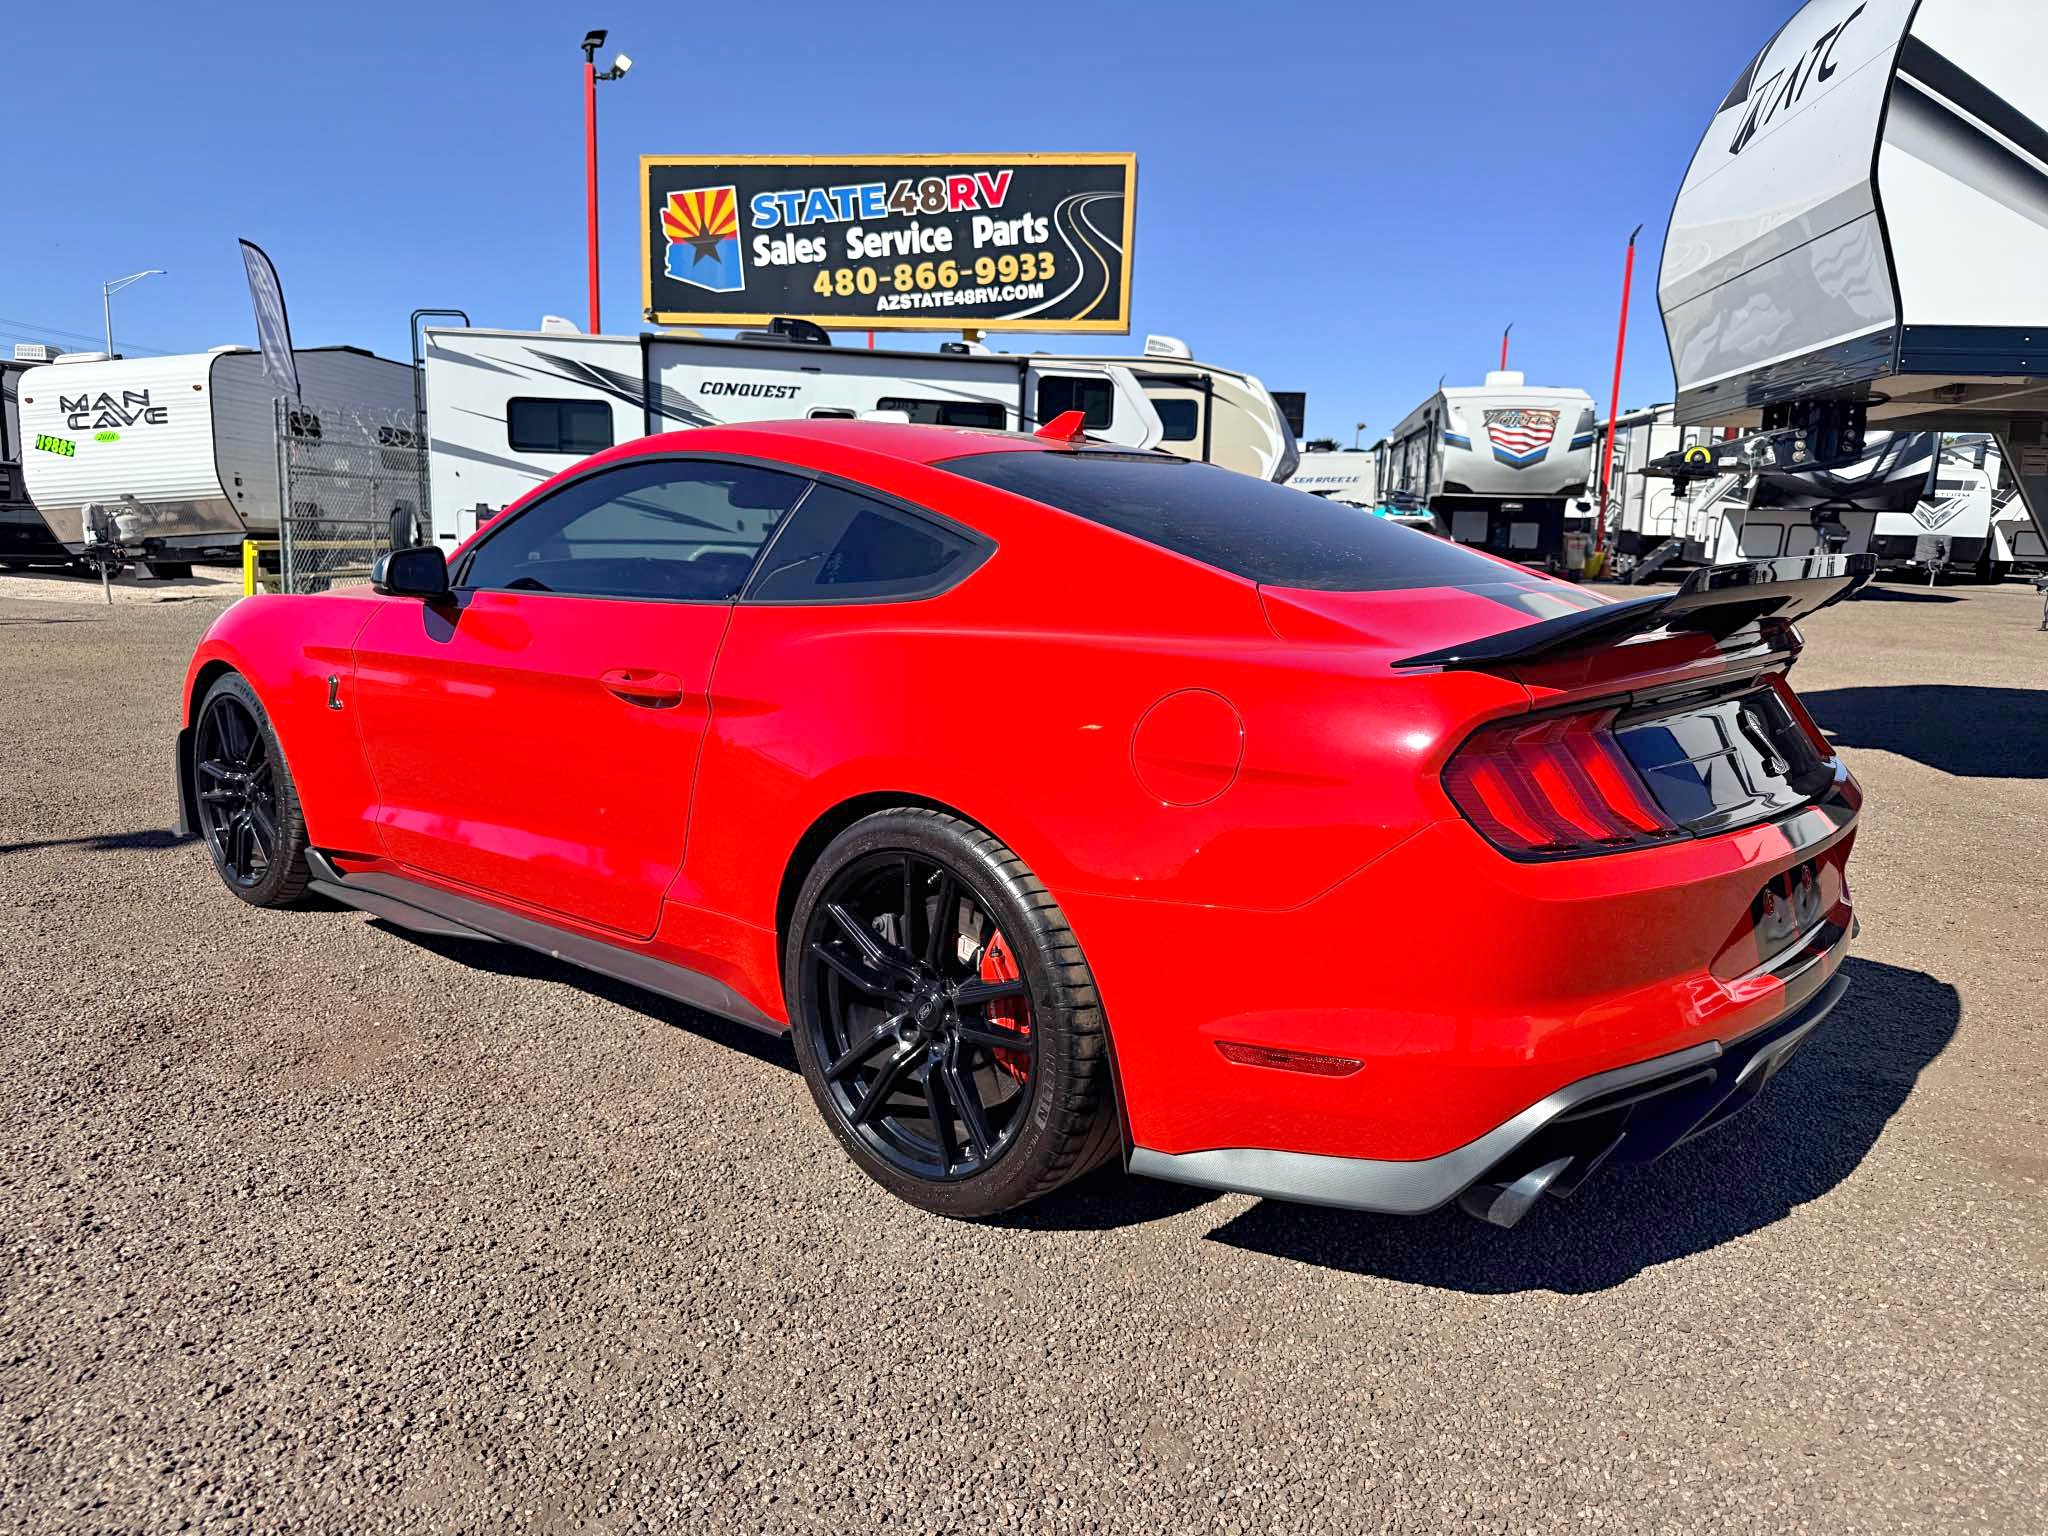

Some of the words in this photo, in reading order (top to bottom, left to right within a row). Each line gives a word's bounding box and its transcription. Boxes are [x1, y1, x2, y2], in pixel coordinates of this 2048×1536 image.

[752, 233, 827, 267] Sales
[846, 221, 953, 259] Service
[972, 212, 1049, 249] Parts
[812, 252, 1056, 298] 480-866-9933
[876, 283, 1044, 311] AZSTATE48RV.COM
[59, 389, 150, 413] MAN
[700, 381, 801, 399] CONQUEST
[67, 407, 168, 430] CAVE
